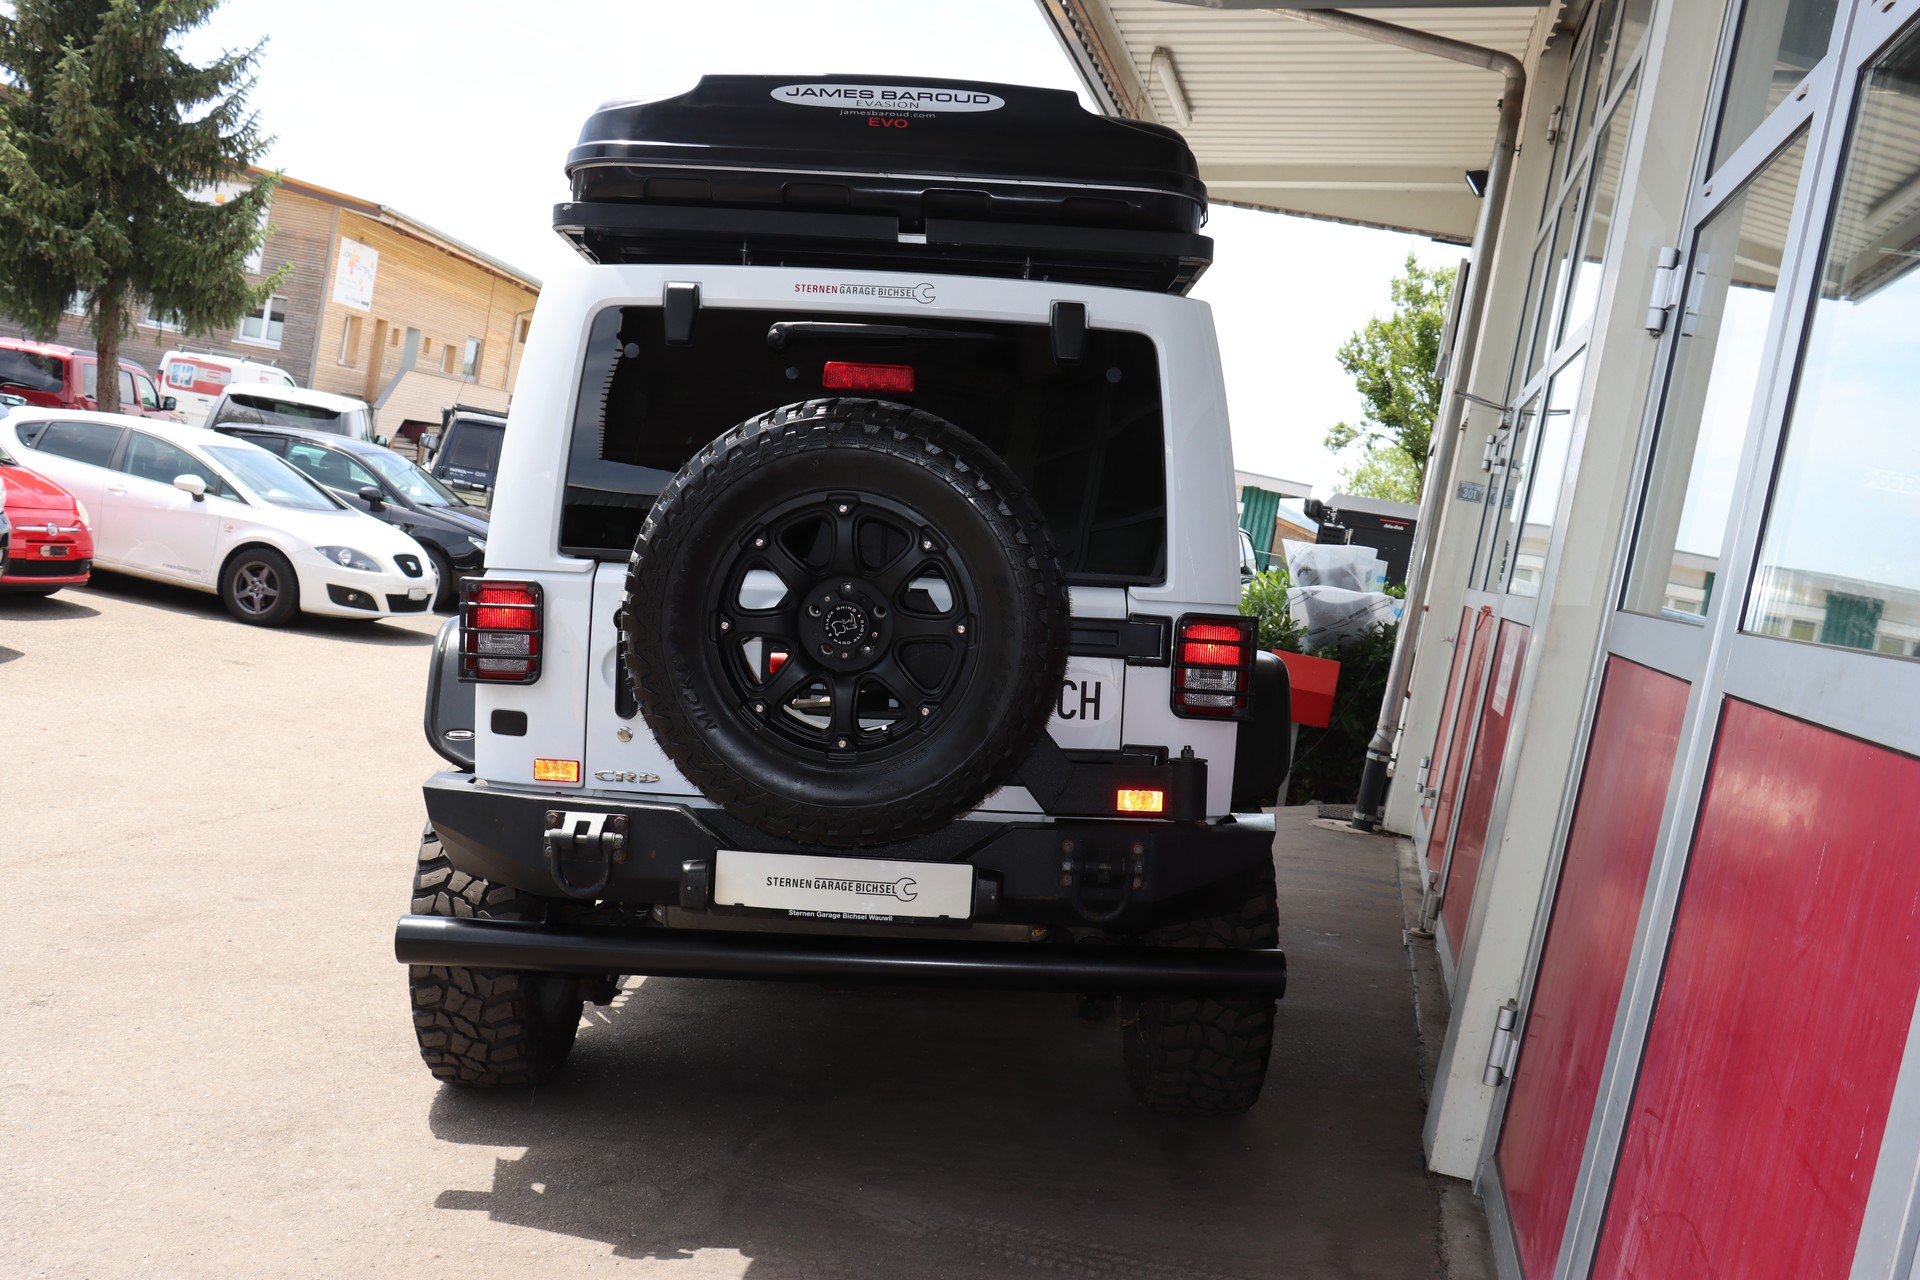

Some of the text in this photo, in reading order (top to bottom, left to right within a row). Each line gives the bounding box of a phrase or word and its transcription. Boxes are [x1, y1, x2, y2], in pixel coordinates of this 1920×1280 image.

[786, 87, 990, 104] JAMES BAROUD
[856, 99, 919, 109] EVASION
[839, 109, 936, 119] jamesbaroud.com
[868, 117, 909, 129] EVO
[794, 283, 917, 298] STERNEN GARAGE BICHSEL
[1462, 488, 1478, 500] 301
[1057, 680, 1102, 721] CH
[594, 769, 661, 784] CRD
[766, 876, 897, 895] STERNEN GARAGE BICHSEL
[788, 908, 893, 922] Sternen Garage Bichsel Wauwil
